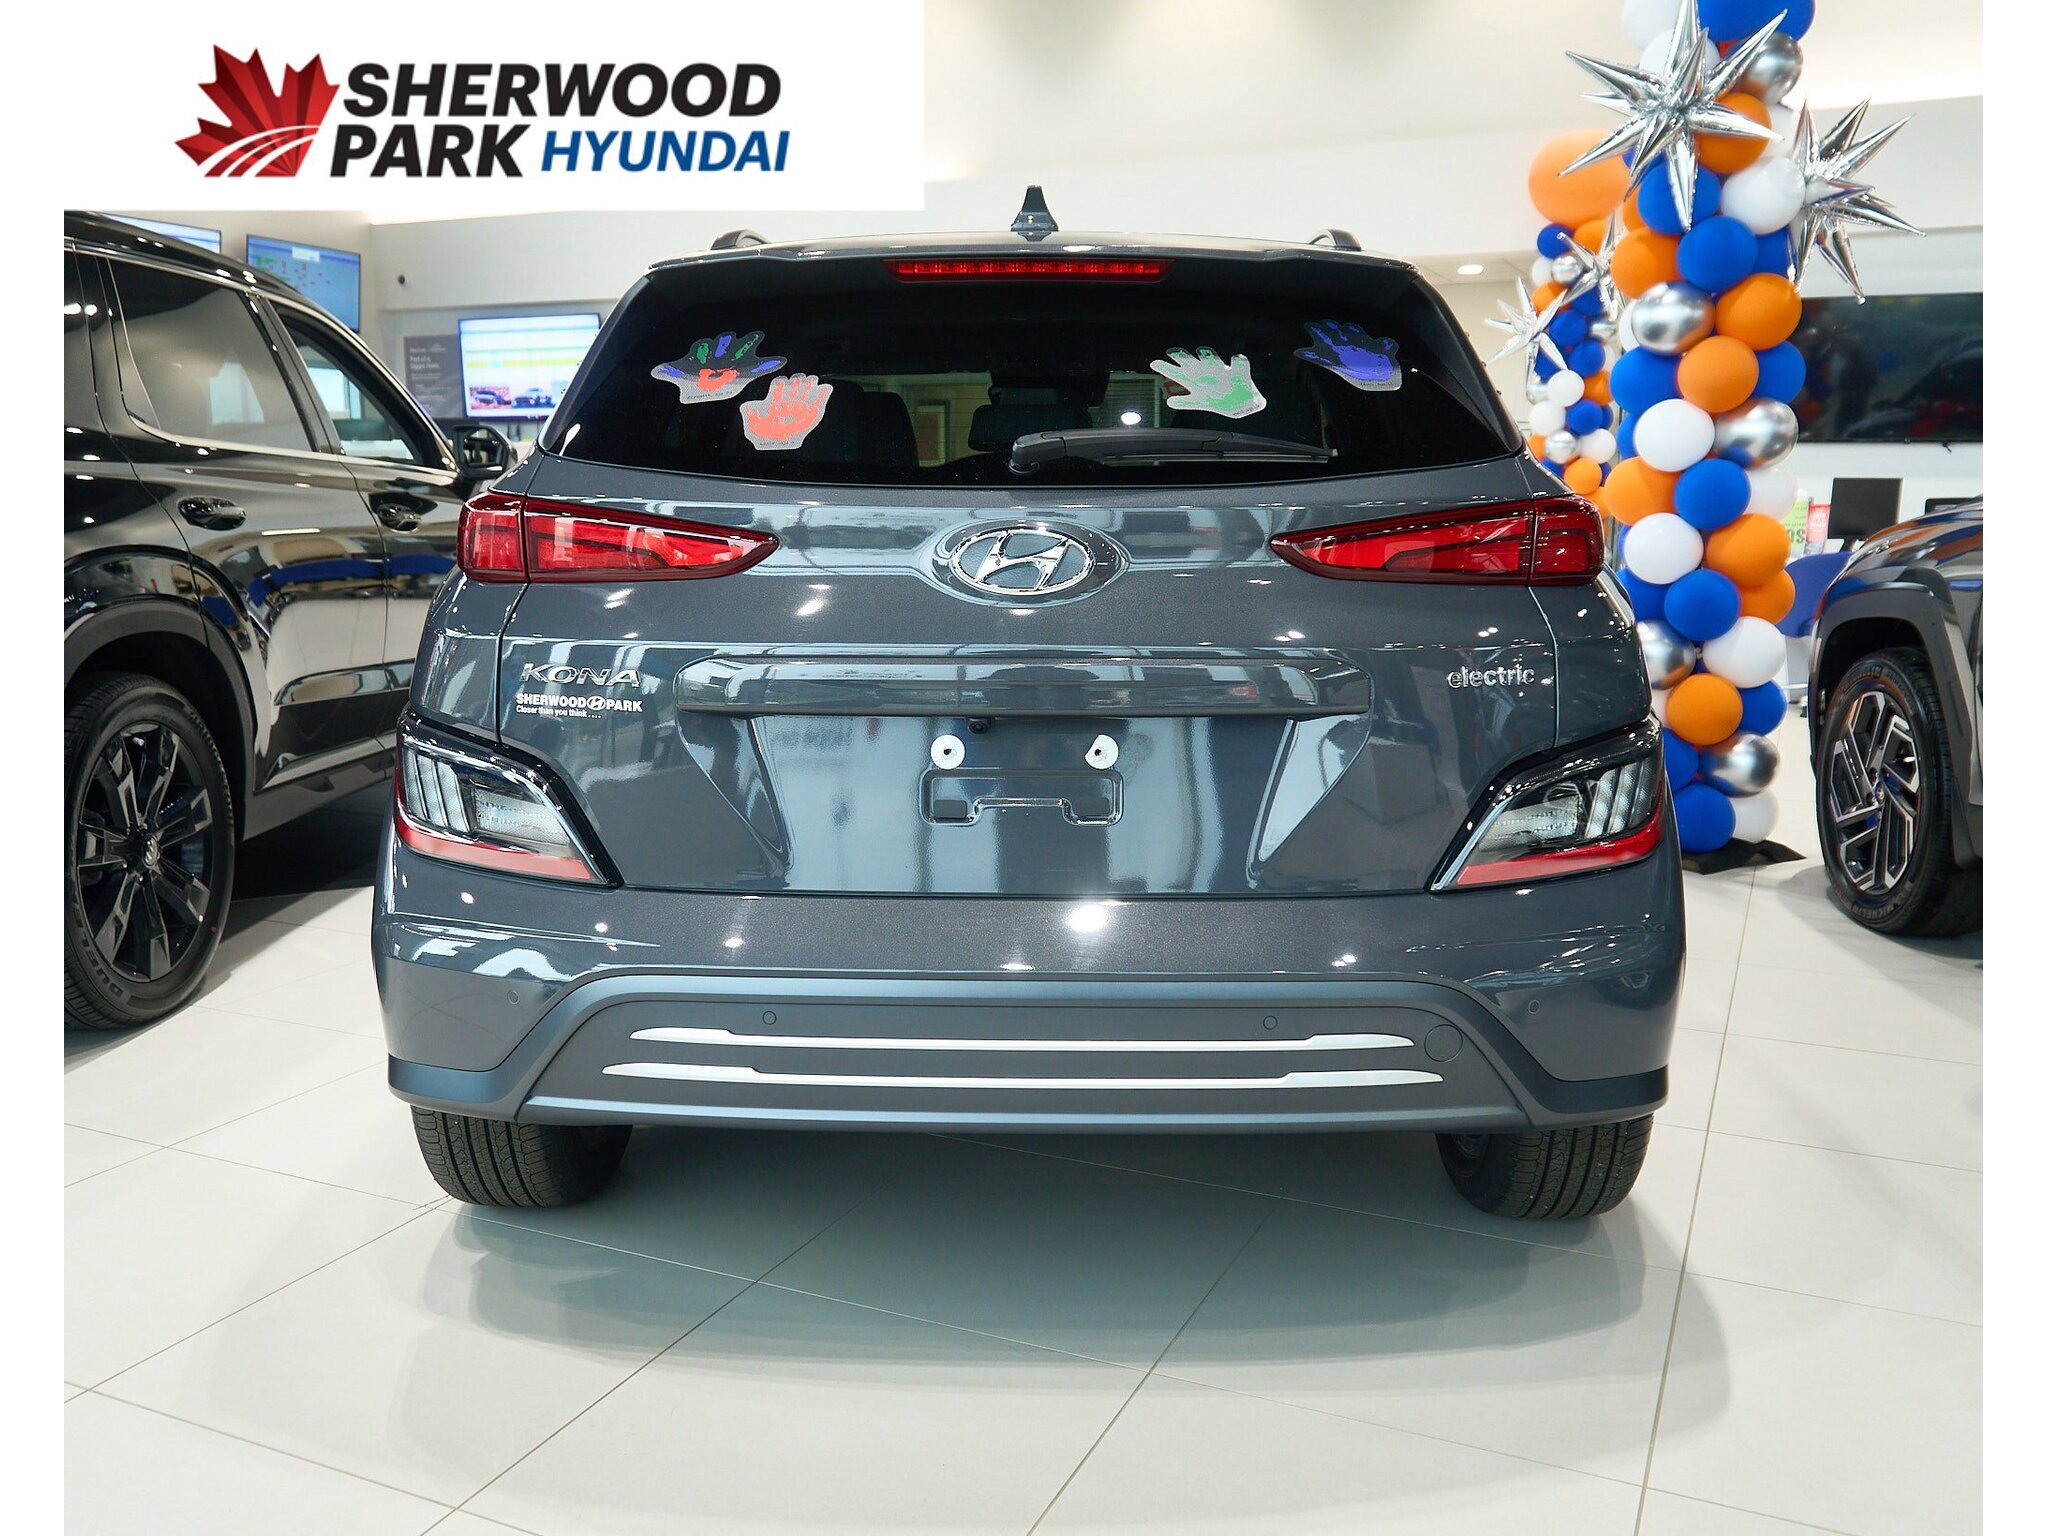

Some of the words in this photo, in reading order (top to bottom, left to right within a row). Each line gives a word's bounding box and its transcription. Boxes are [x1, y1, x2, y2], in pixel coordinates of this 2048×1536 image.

[520, 663, 641, 688] KONA
[1446, 663, 1535, 689] electric
[516, 693, 587, 708] SHERWOOD
[605, 698, 643, 712] PARK
[516, 705, 538, 714] Closer
[538, 707, 554, 715] than
[555, 709, 568, 717] you
